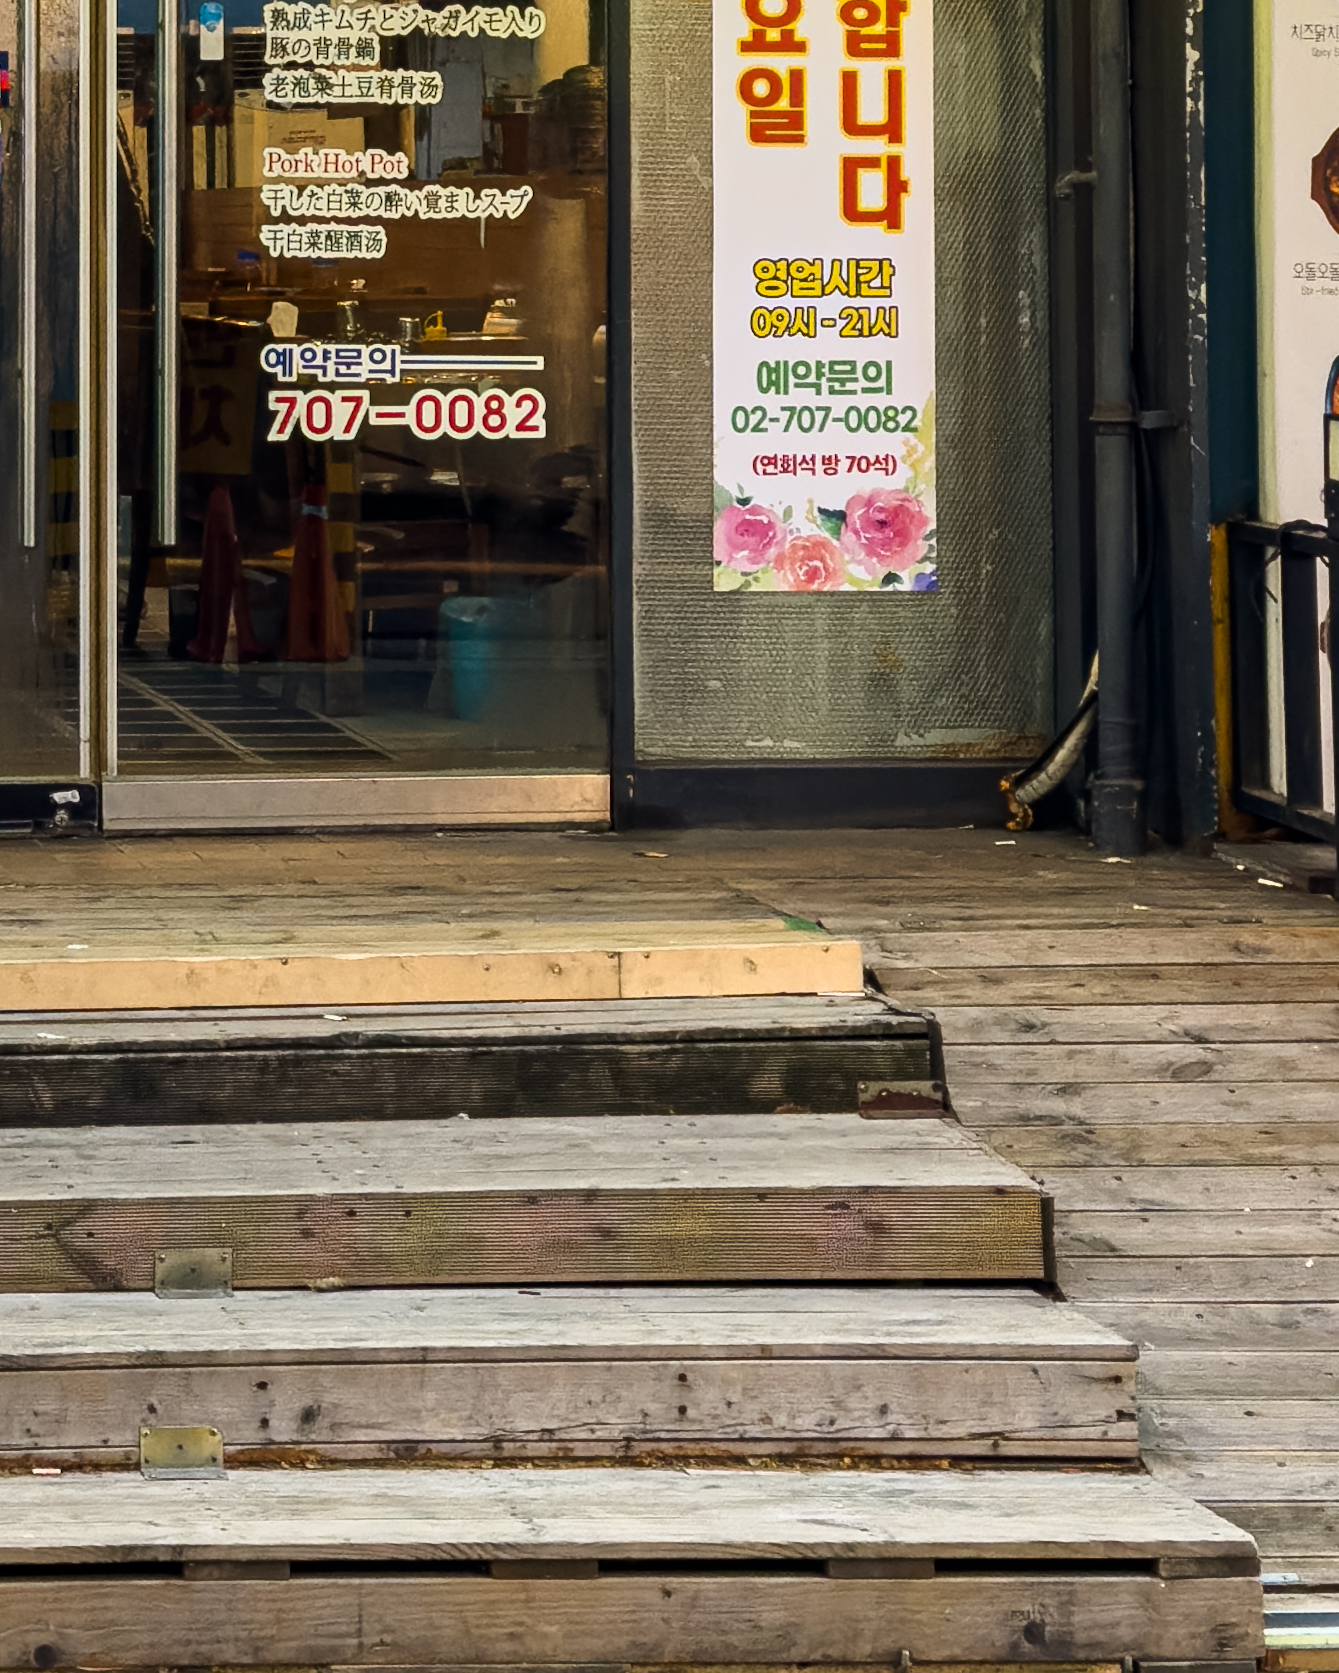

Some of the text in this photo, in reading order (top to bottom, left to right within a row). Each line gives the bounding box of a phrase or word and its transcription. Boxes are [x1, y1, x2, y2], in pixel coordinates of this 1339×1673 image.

[269, 6, 546, 35] 熟成キムチとジャガイモ入り
[268, 36, 375, 61] 豚の背骨鍋
[267, 153, 405, 175] Pork Hot Pot
[265, 228, 383, 253] 干白菜醒酒汤
[753, 257, 896, 298] 영업시간
[264, 347, 397, 379] 예약문의
[756, 360, 893, 396] 예약문의
[730, 405, 919, 434] 02-707-0082
[752, 453, 898, 476] (연회석 방 70석)
